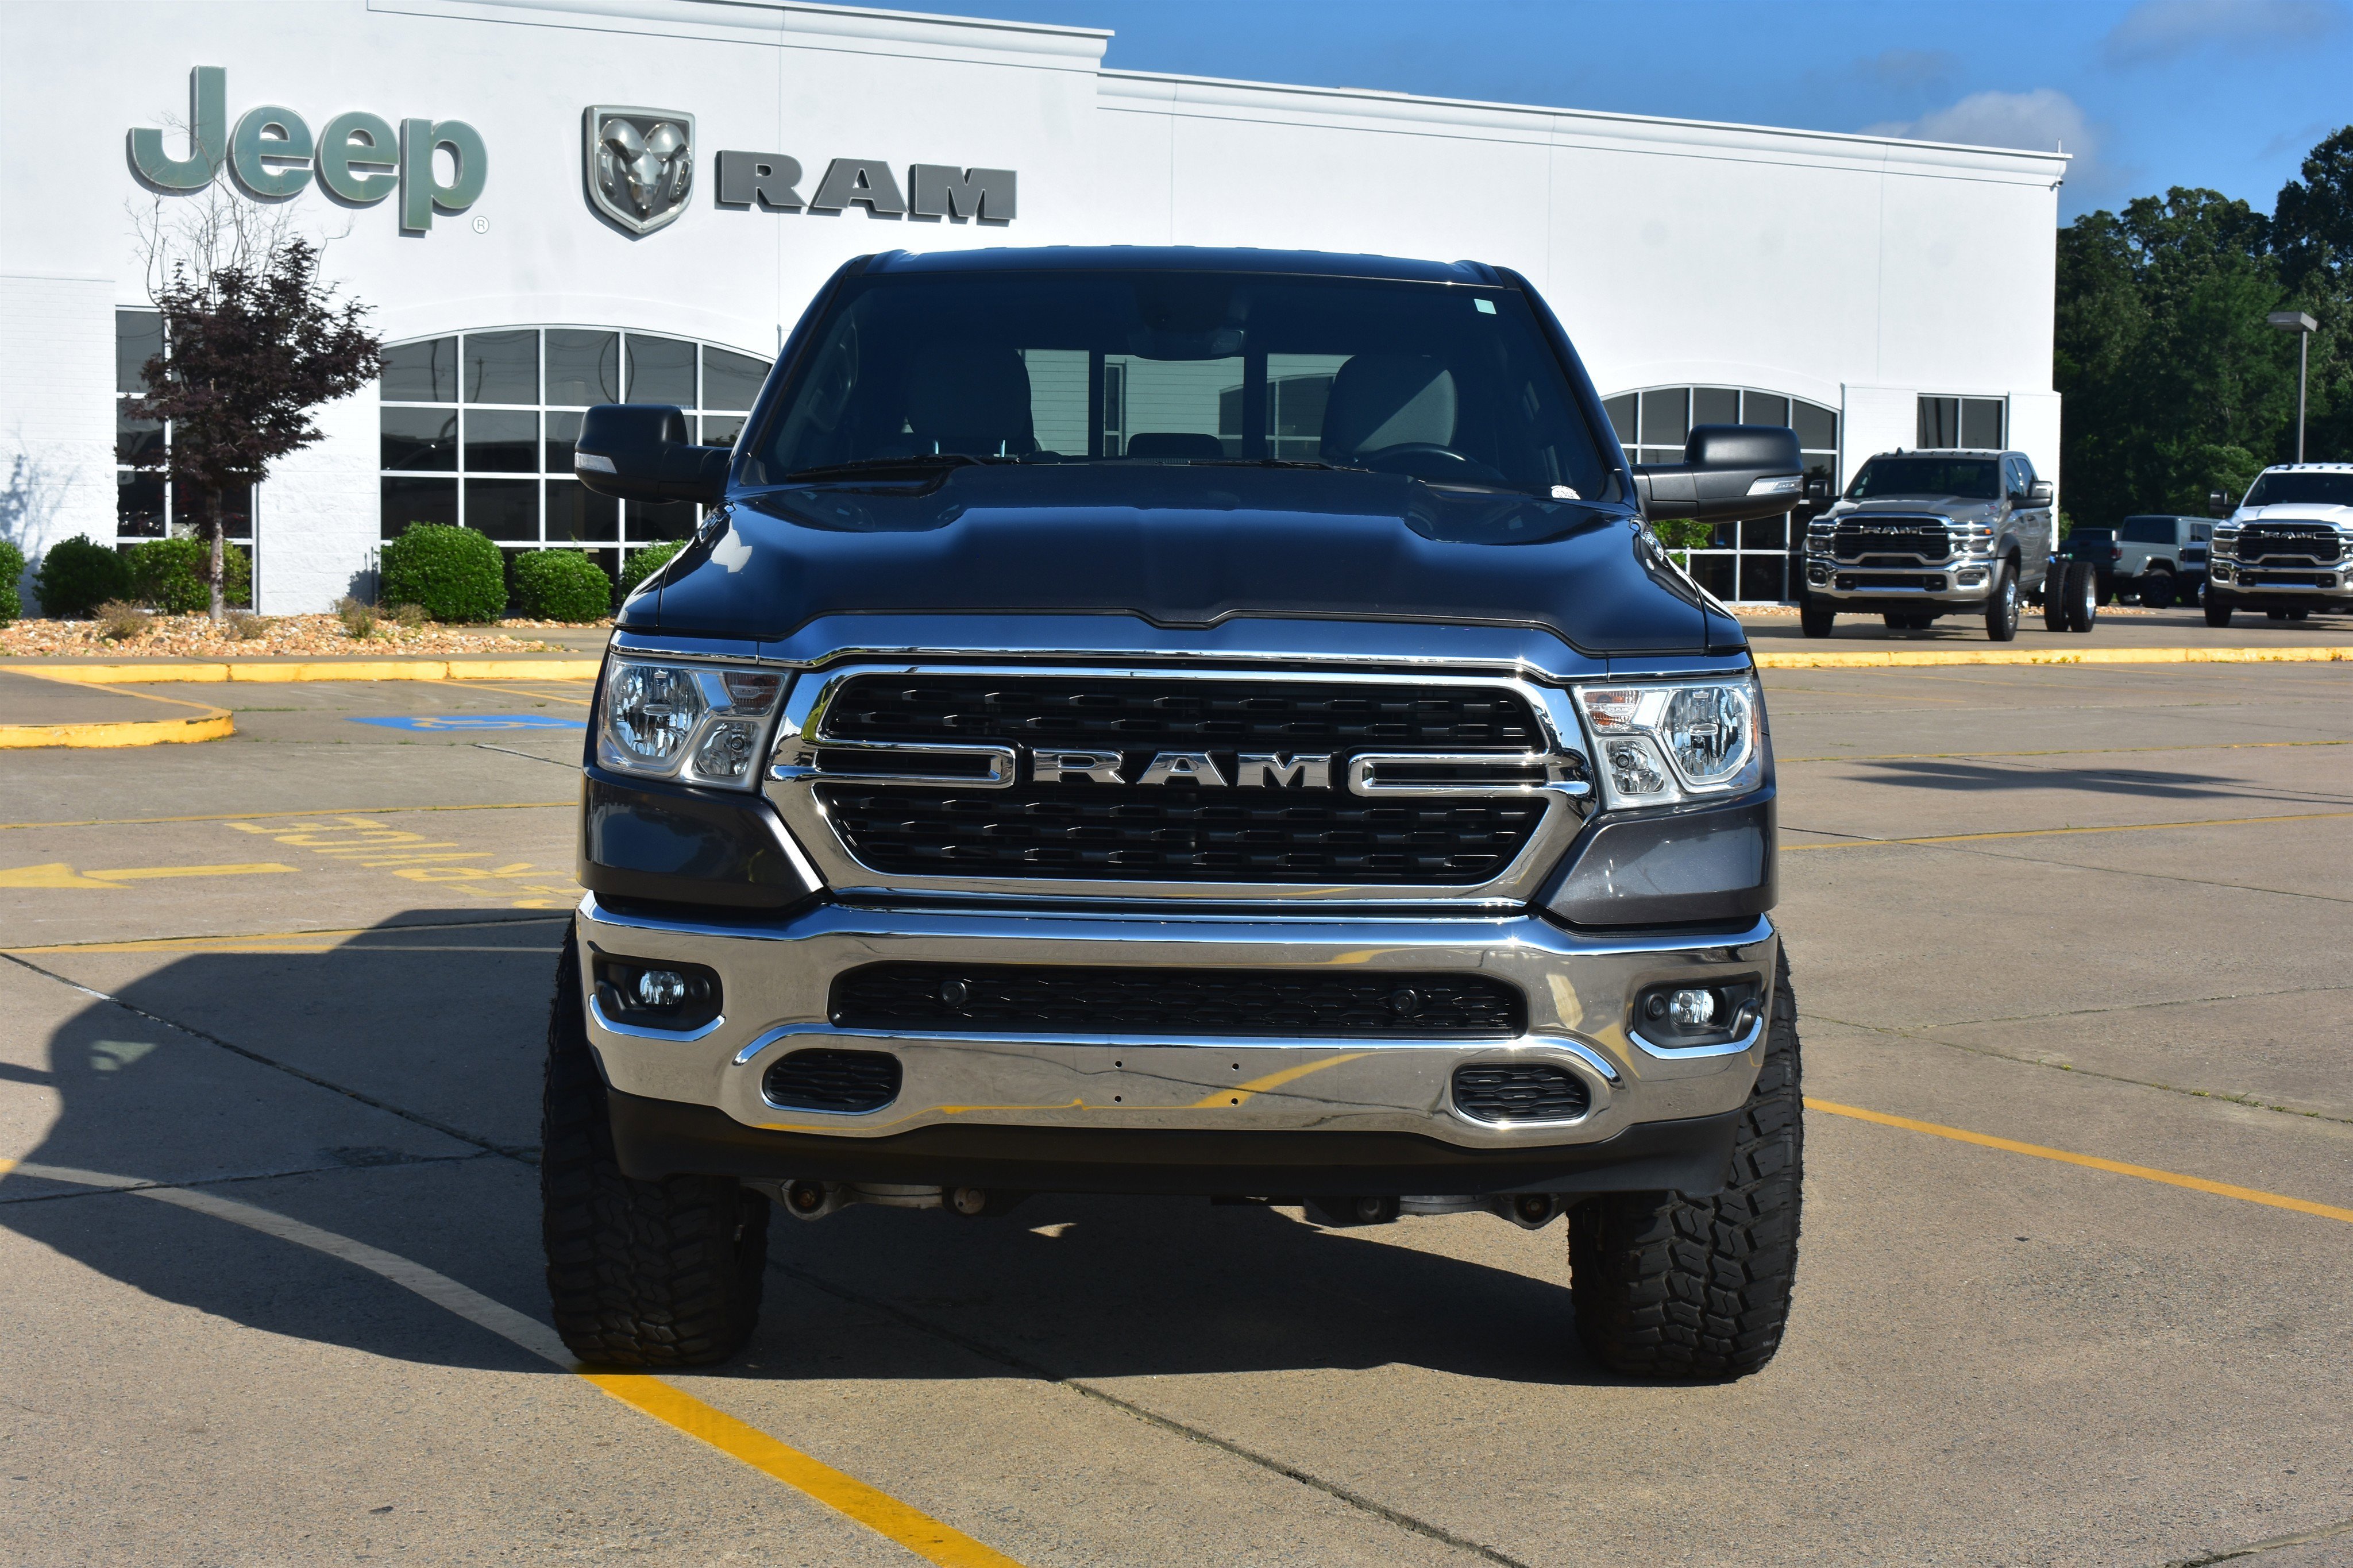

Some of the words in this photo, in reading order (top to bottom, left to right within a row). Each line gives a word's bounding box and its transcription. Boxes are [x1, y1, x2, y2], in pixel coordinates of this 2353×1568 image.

[126, 64, 489, 232] Jeep
[715, 150, 1017, 221] RAM
[1863, 526, 1919, 534] RAM
[1033, 748, 1332, 789] RAM
